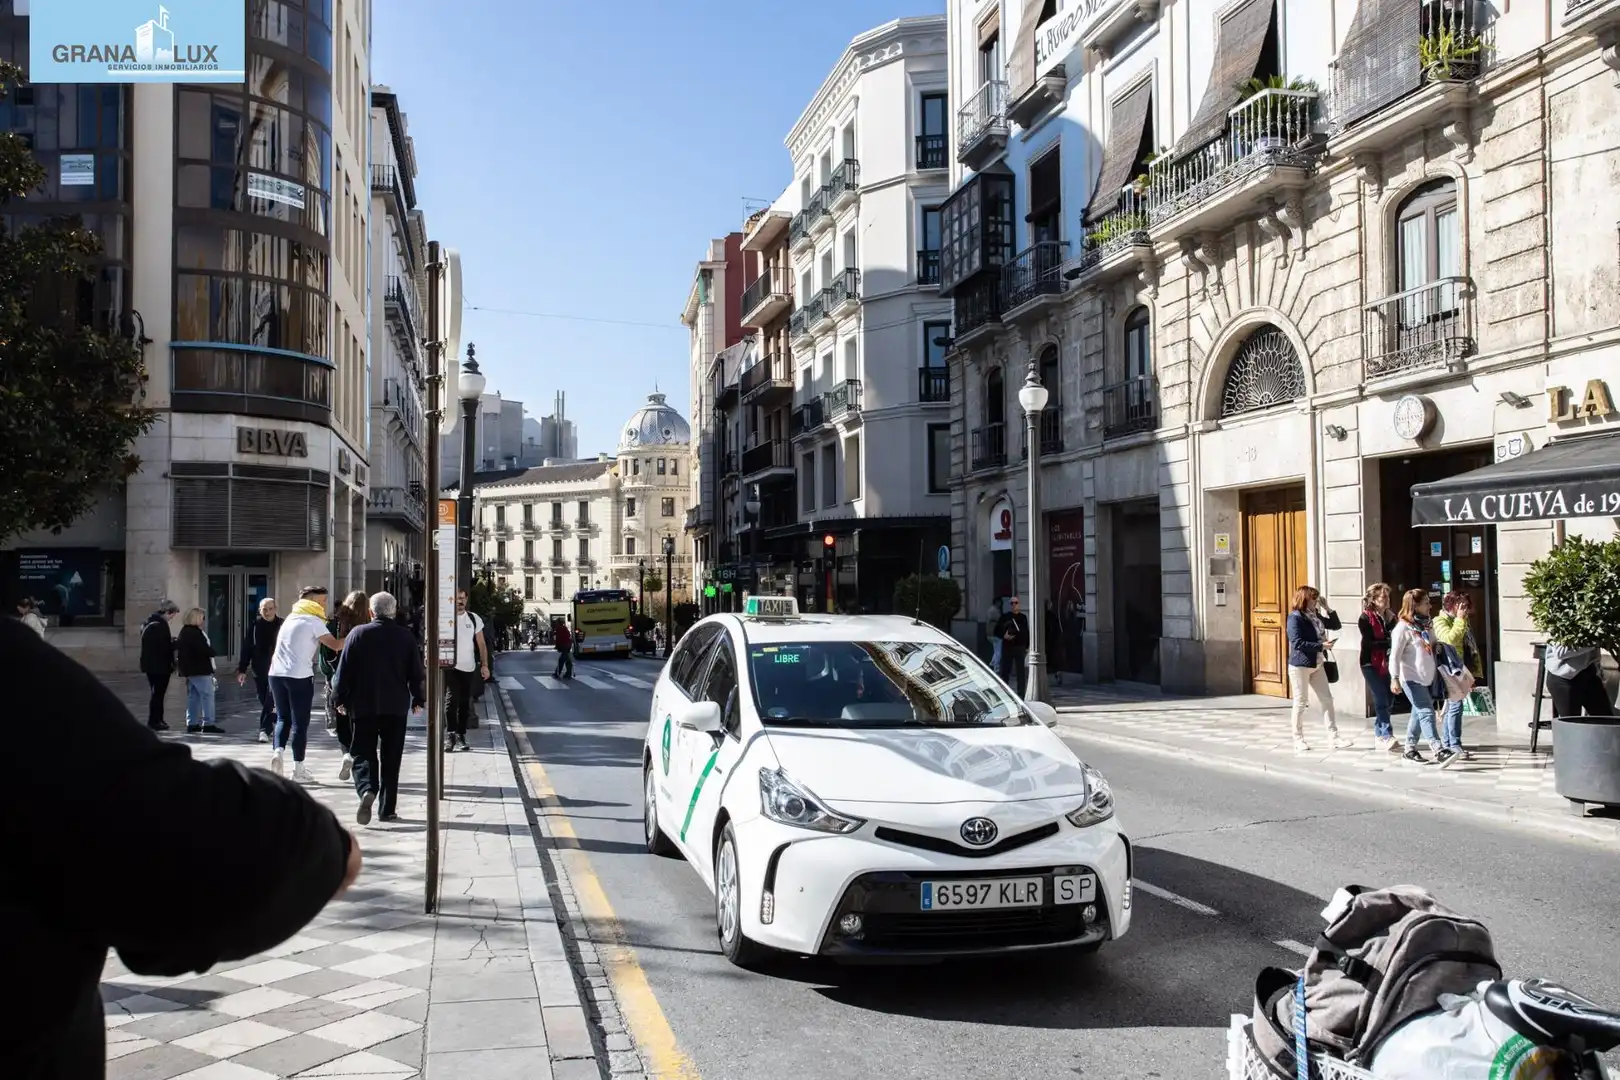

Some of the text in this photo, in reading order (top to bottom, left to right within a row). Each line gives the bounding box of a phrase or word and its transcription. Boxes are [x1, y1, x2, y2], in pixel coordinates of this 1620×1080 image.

[1047, 4, 1083, 56] RUIDO
[1546, 378, 1610, 423] LA
[236, 426, 309, 458] BBVA
[1443, 489, 1620, 522] LA CUEVA de 19
[761, 600, 783, 613] TAXI
[774, 654, 800, 663] LIBRE
[937, 882, 1038, 906] 6597 KLR
[1060, 877, 1092, 900] SP
